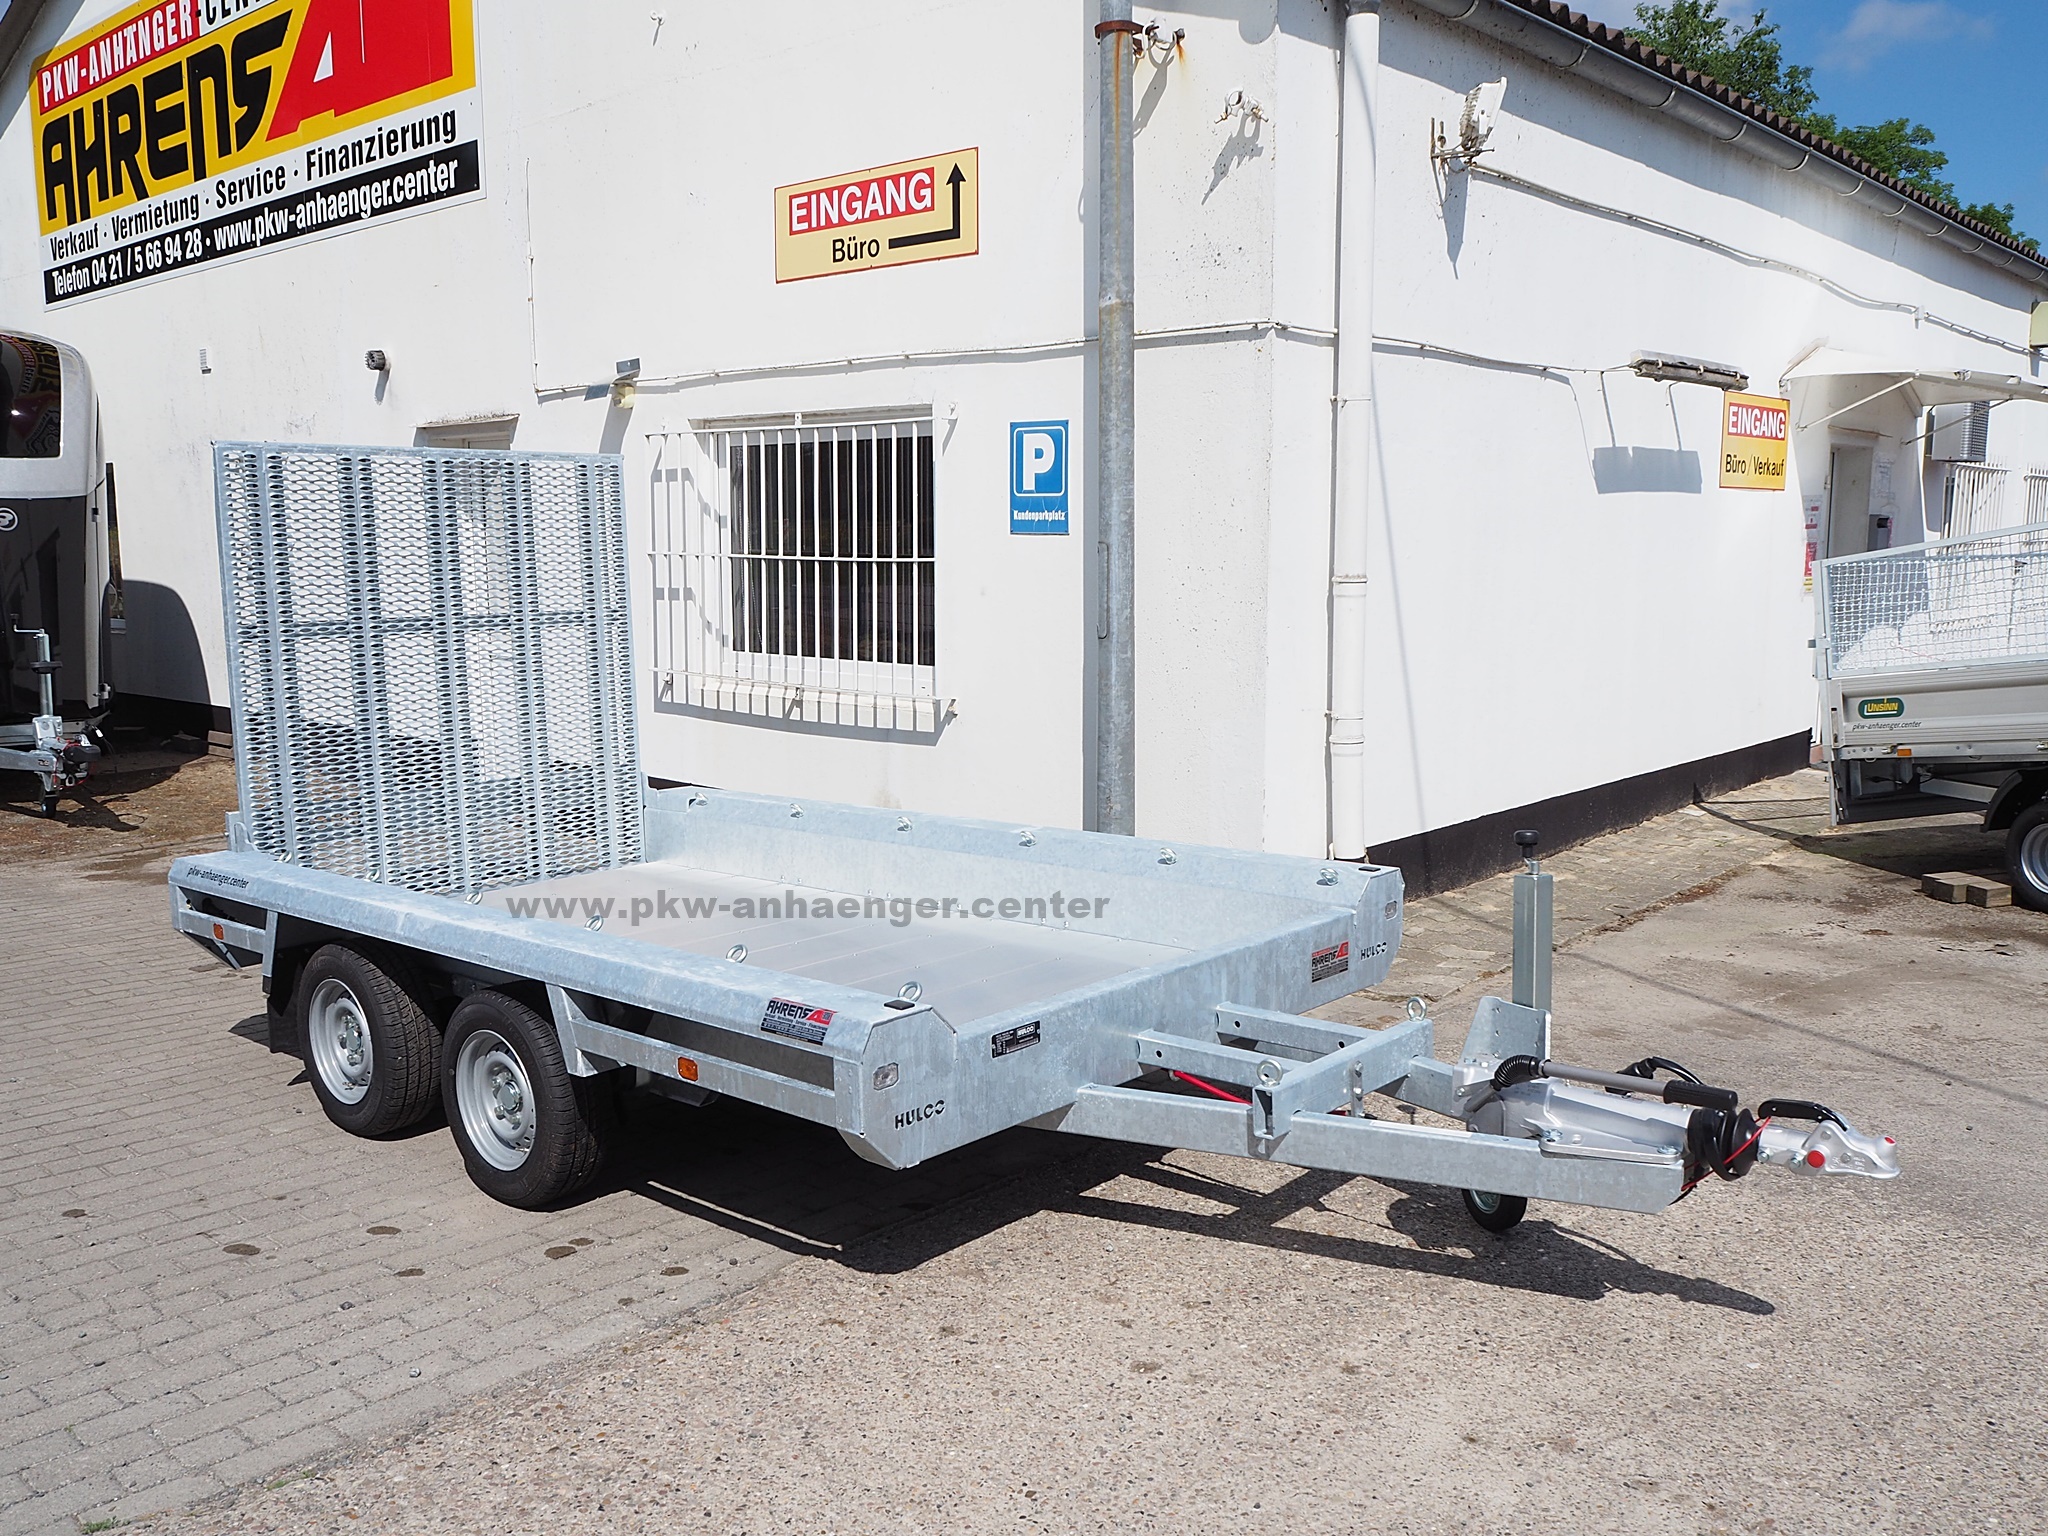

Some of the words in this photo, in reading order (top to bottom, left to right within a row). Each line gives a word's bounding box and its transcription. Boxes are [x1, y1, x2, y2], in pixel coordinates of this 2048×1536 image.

[42, 0, 260, 107] PKW-ANHÄNGER-C
[42, 9, 293, 226] AHRENS
[50, 223, 99, 261] Verkauf
[112, 194, 199, 241] Vermietung
[216, 165, 286, 208] Service
[307, 109, 456, 181] Finanzierung
[792, 172, 932, 232] EINGANG
[52, 267, 90, 295] Telefon
[92, 258, 107, 286] 04
[109, 252, 124, 281] 21
[135, 246, 144, 273] 5
[146, 240, 162, 269] 66
[165, 232, 182, 264] 94
[185, 228, 202, 259] 28
[215, 158, 458, 250] www.pkw-anhaenger.center
[832, 236, 880, 263] Büro
[1729, 405, 1785, 438] EINGANG
[1022, 433, 1055, 490] P
[1726, 454, 1746, 474] Büro
[1754, 456, 1784, 476] Verkauf
[1013, 509, 1065, 521] Kundenparkplatz
[1867, 699, 1898, 712] UNSINN
[1852, 721, 1921, 732] pkw-anhaenger.center
[186, 866, 249, 888] pkw-anhaenger.center
[766, 1000, 815, 1020] AHRENS
[895, 1099, 945, 1129] HULCO
